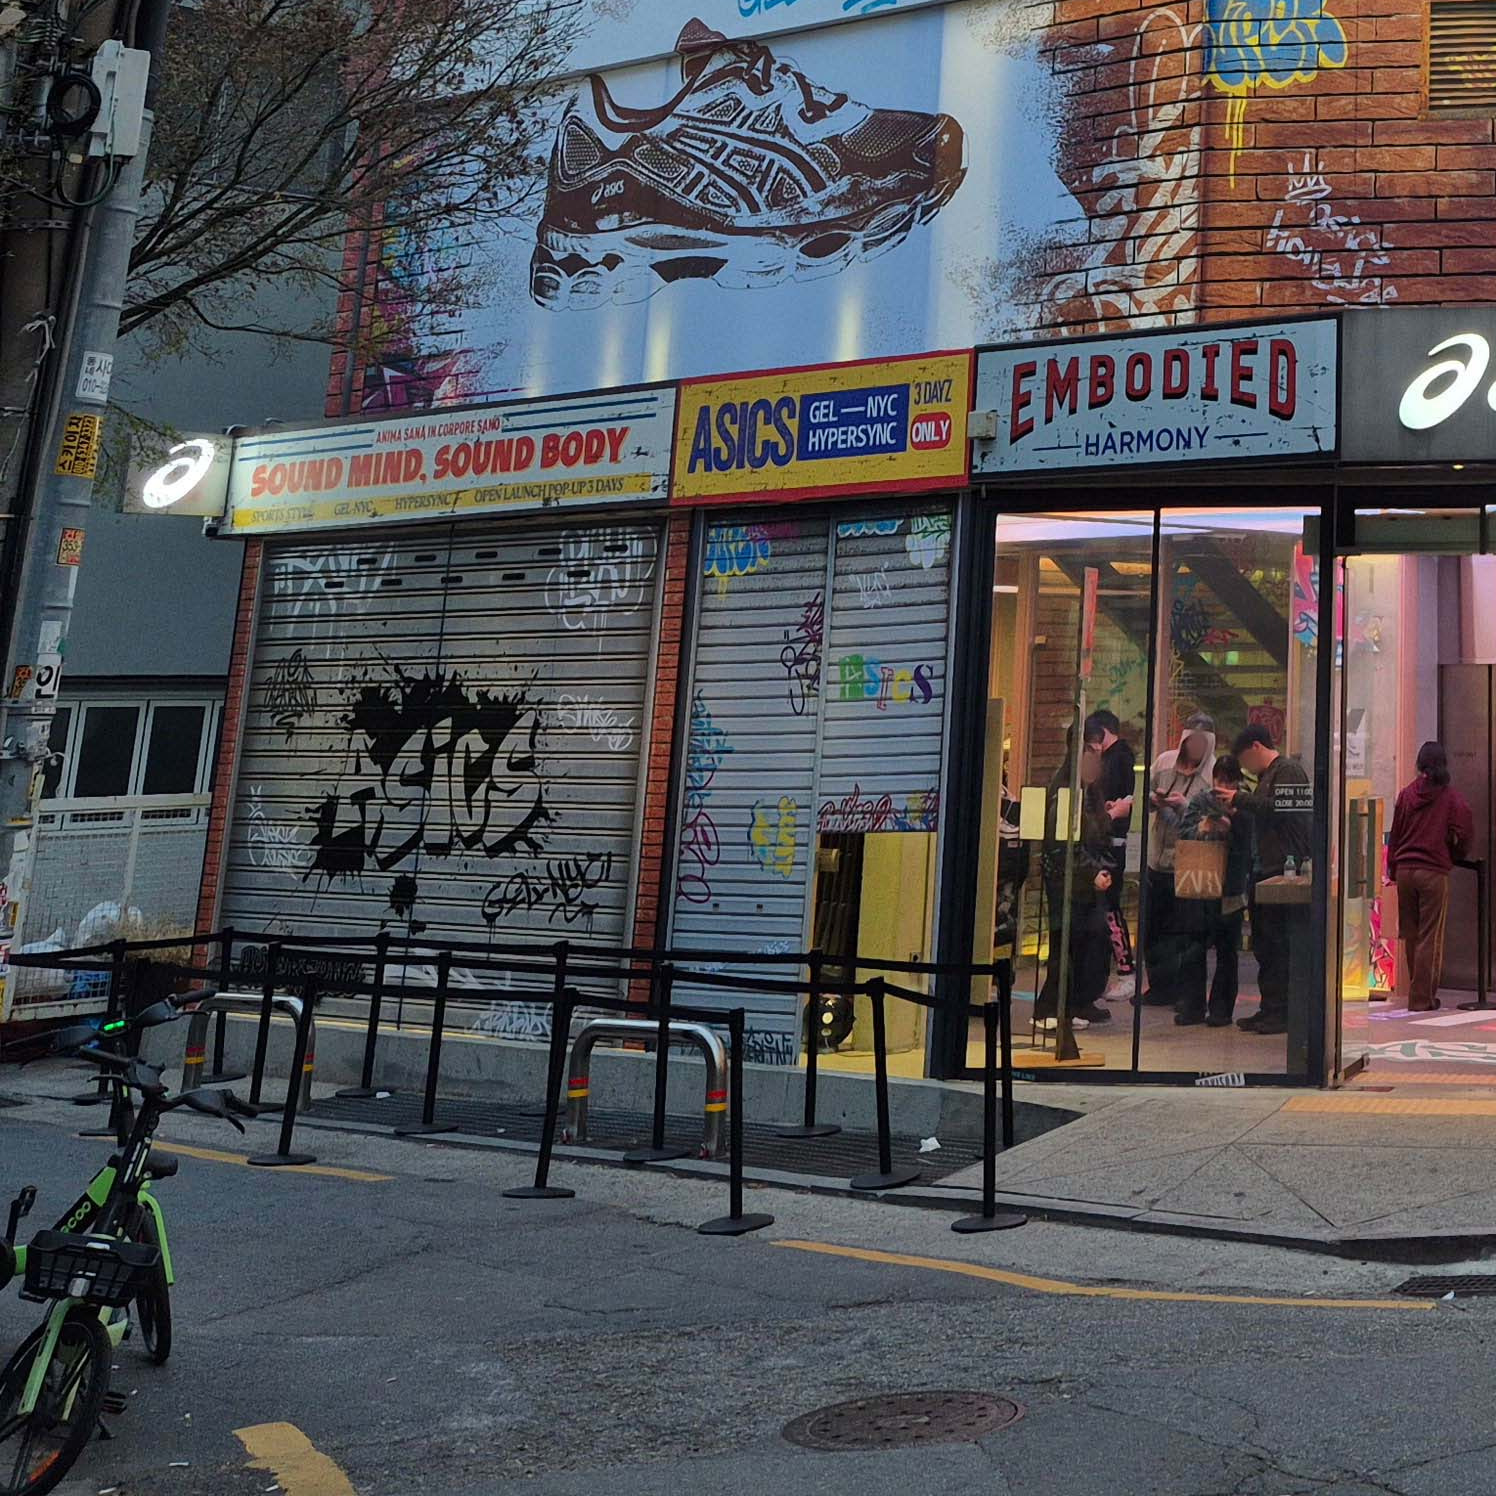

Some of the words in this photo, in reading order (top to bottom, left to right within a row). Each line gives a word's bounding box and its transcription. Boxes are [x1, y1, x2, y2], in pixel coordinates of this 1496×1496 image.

[1009, 338, 1299, 446] EMBODIED
[376, 428, 402, 444] ANIMA
[404, 423, 426, 441] SANA
[427, 421, 437, 438] IN
[438, 417, 476, 438] CORPORE
[686, 394, 797, 474] ASICS
[808, 421, 898, 453] HYPERSYNC
[911, 418, 950, 444] ONLY
[1084, 425, 1212, 458] HARMONY
[251, 456, 344, 498] SOUND
[347, 447, 427, 488] MIND,
[433, 435, 536, 480] SOUND
[540, 426, 630, 470] BODY
[474, 489, 501, 503] OPEN
[504, 485, 546, 500] LAUNCH
[549, 481, 586, 497] POP-UP
[596, 478, 625, 492] DAYS
[840, 654, 934, 710] ASICS
